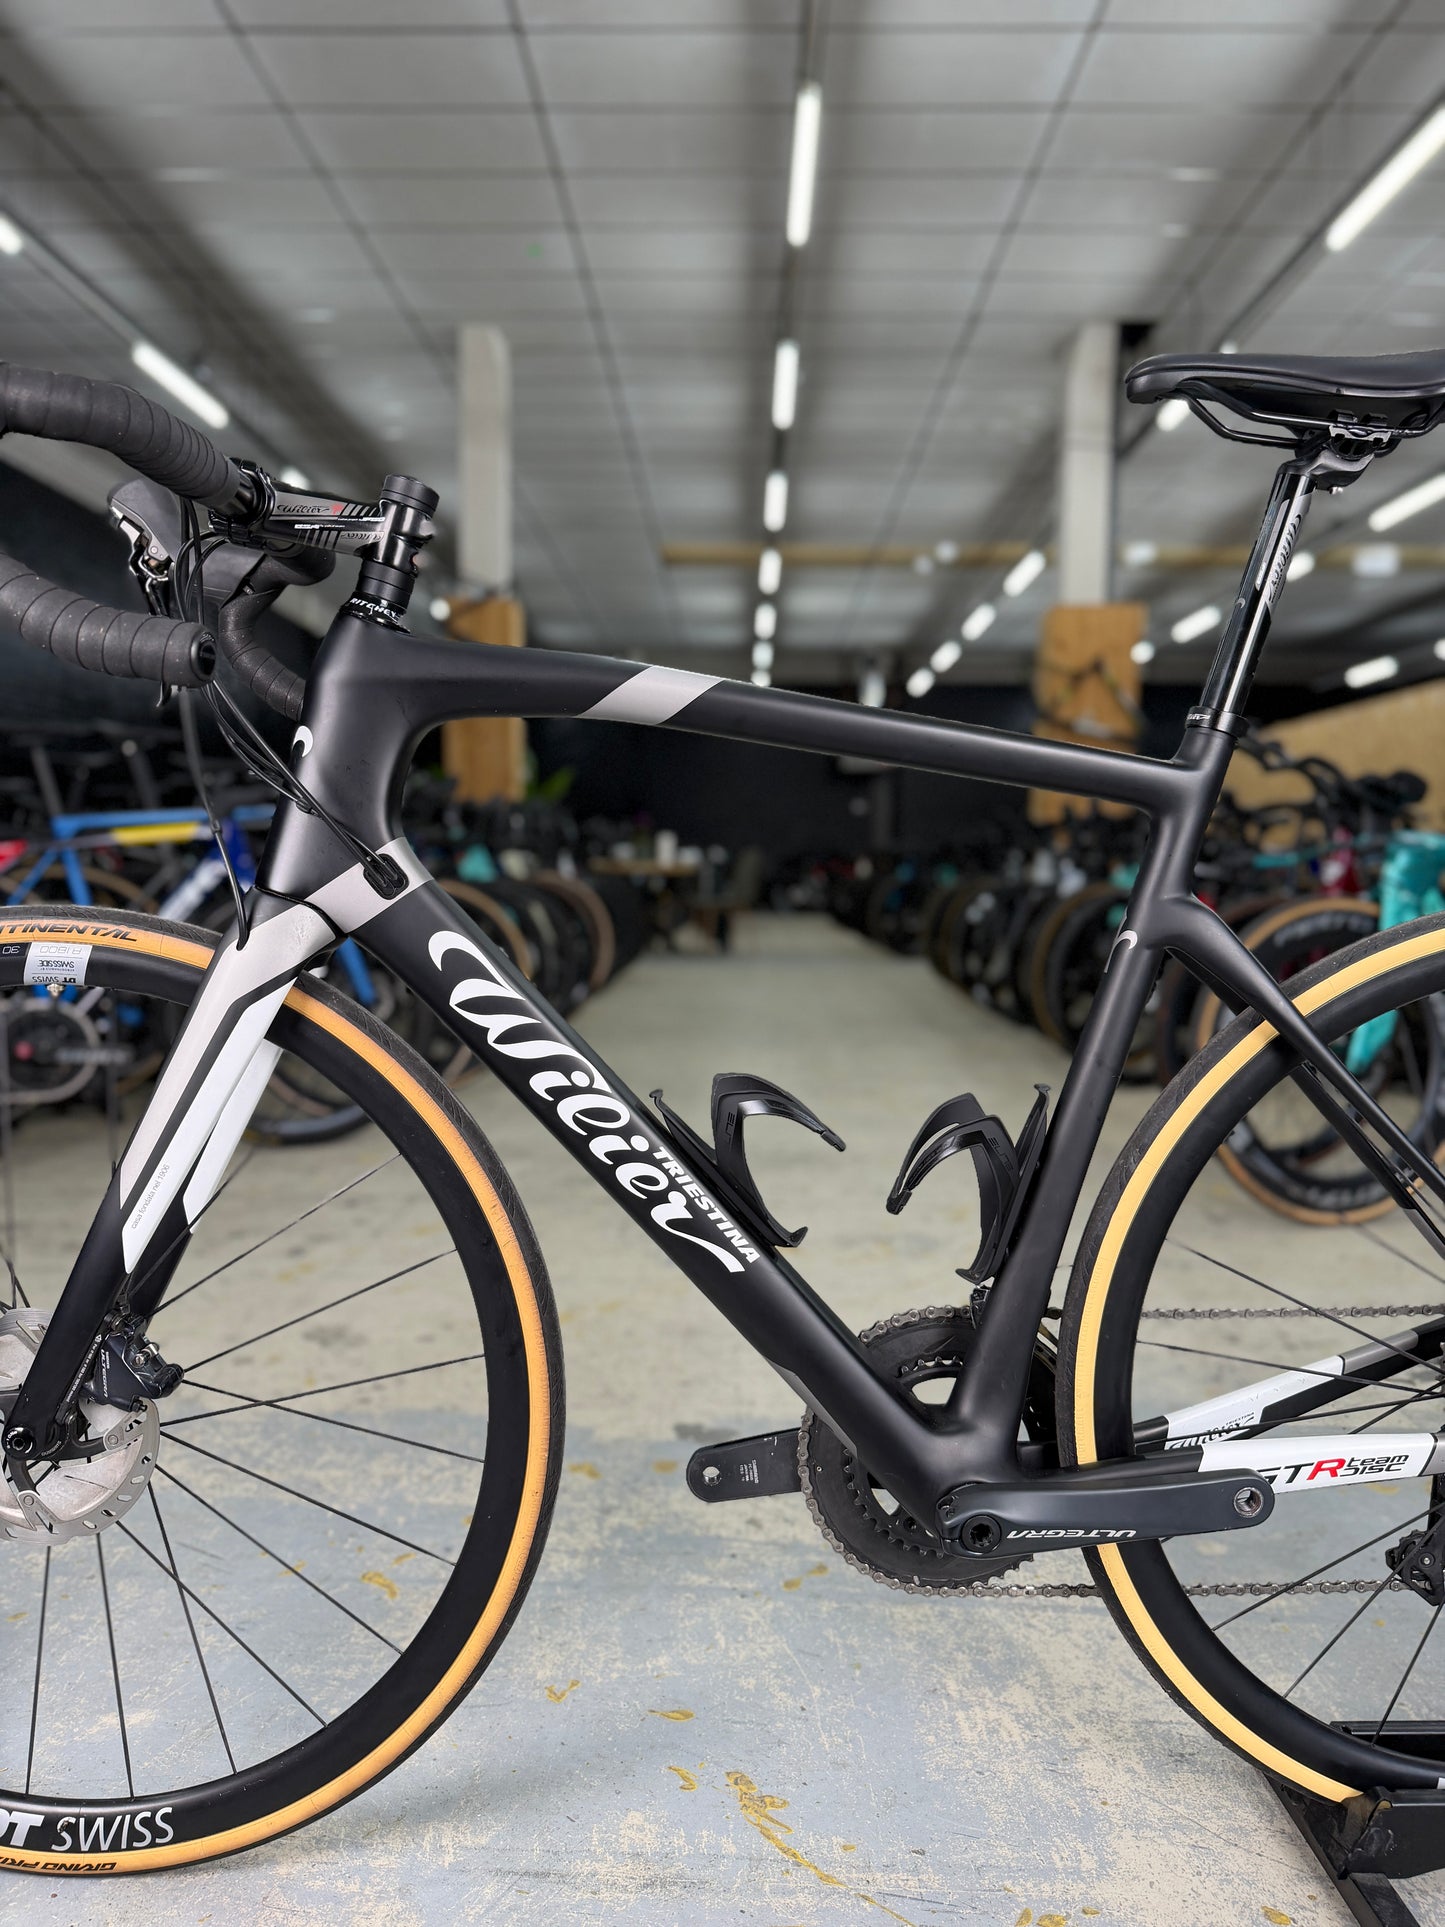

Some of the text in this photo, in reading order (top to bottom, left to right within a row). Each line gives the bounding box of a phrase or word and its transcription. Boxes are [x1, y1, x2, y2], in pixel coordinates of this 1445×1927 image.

[428, 930, 745, 1273] Wilier
[652, 1146, 761, 1263] TRIESTINA
[1346, 1454, 1410, 1468] team
[1006, 1529, 1137, 1539] ULTEGRA
[51, 1806, 175, 1852] SWISS
[0, 1855, 117, 1872] GRAND PRI
